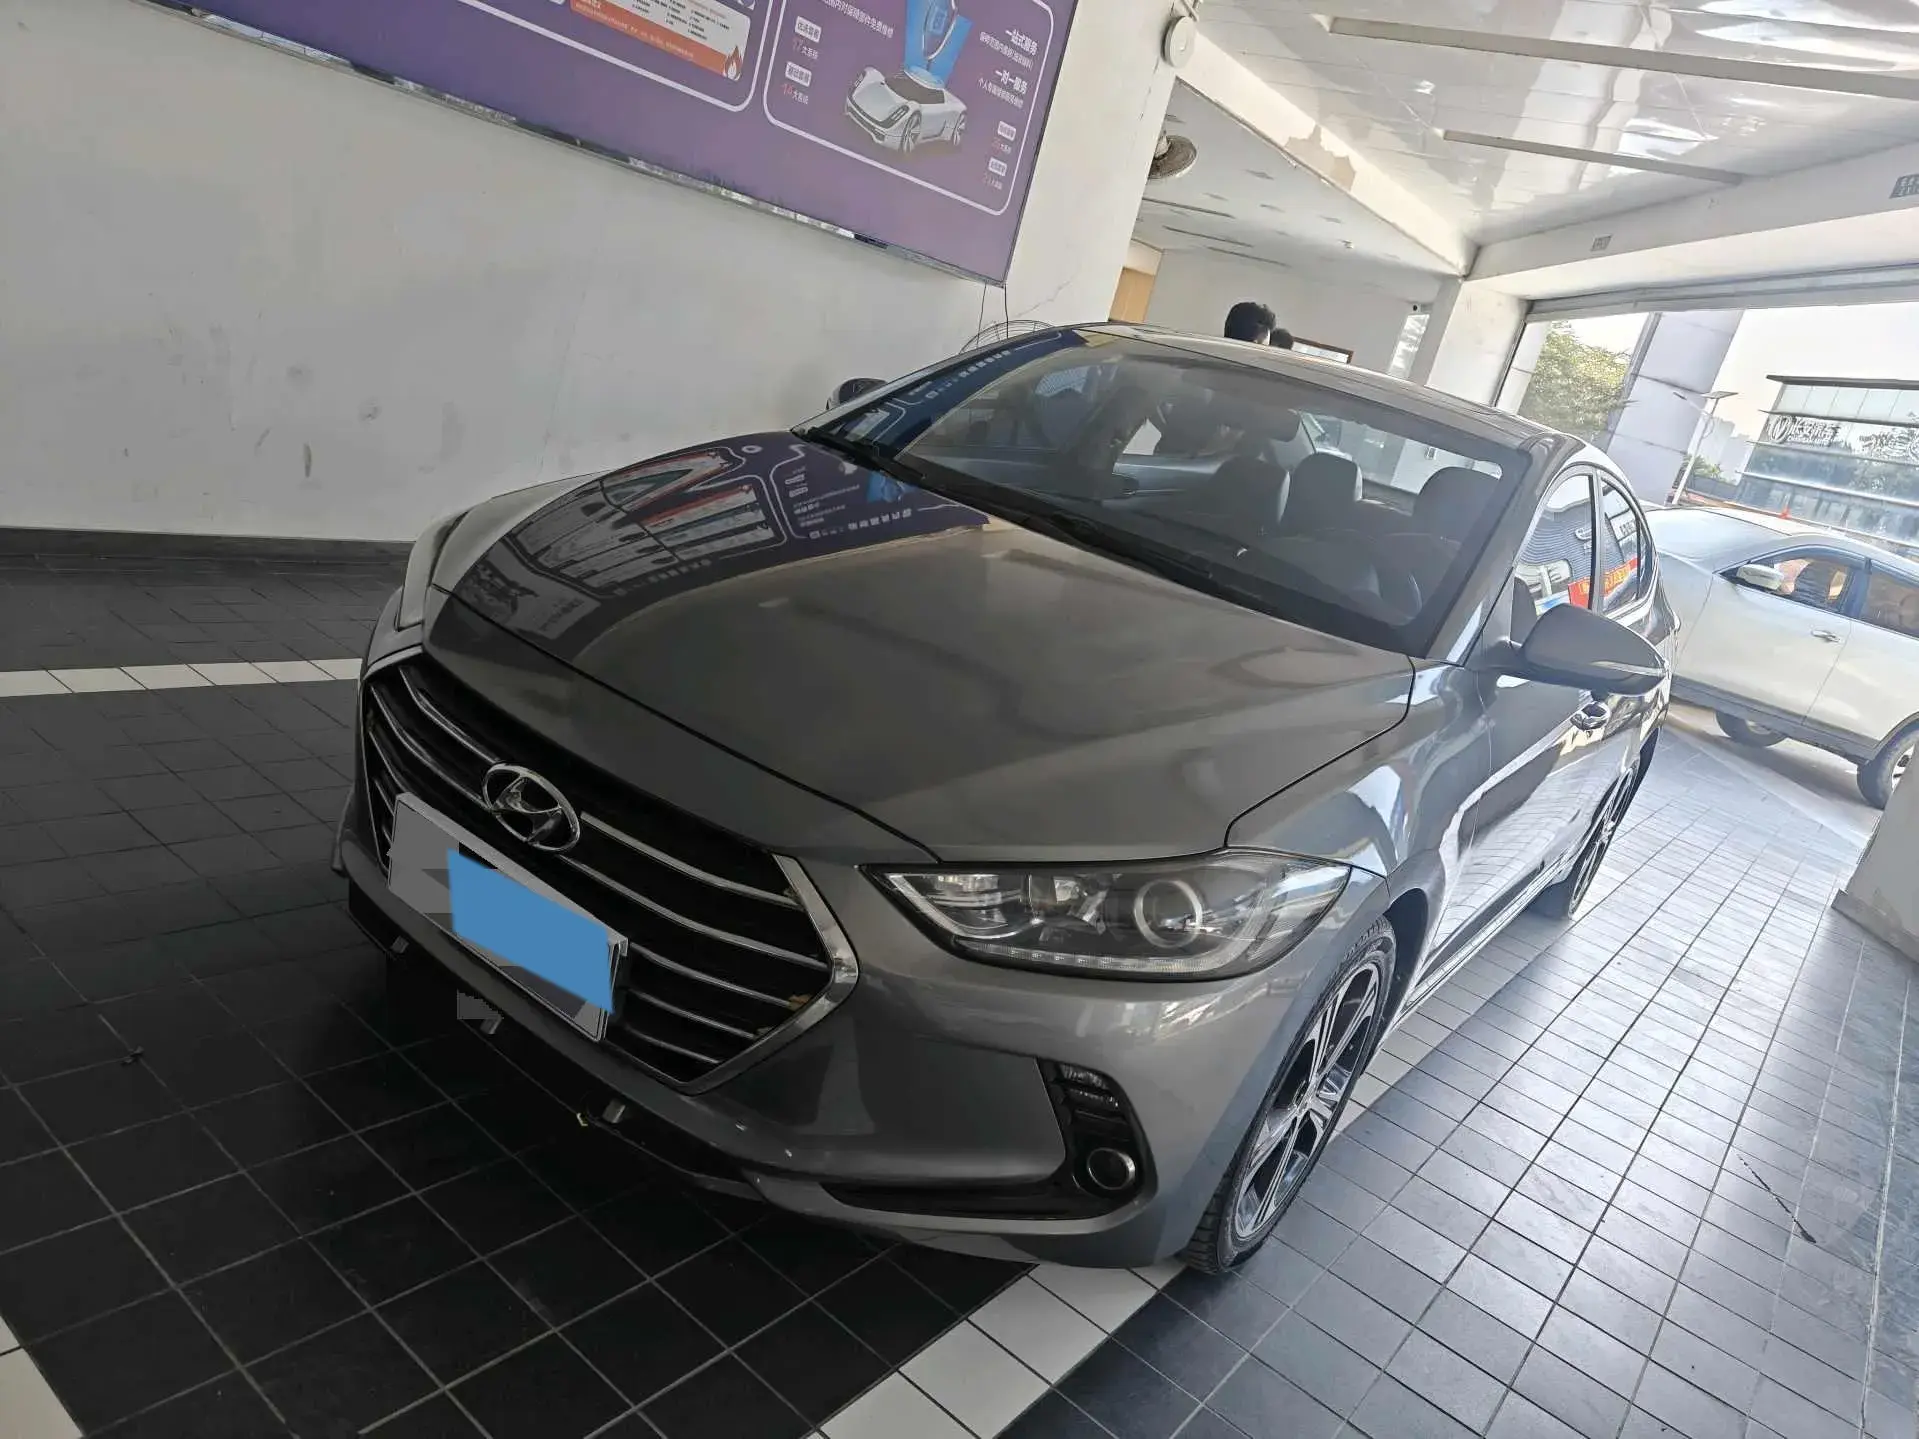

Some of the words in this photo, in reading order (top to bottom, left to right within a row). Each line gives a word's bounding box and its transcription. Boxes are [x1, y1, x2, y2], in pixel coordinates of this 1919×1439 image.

[1005, 29, 1038, 56] 一站式服务
[995, 70, 1028, 95] 一对一服务
